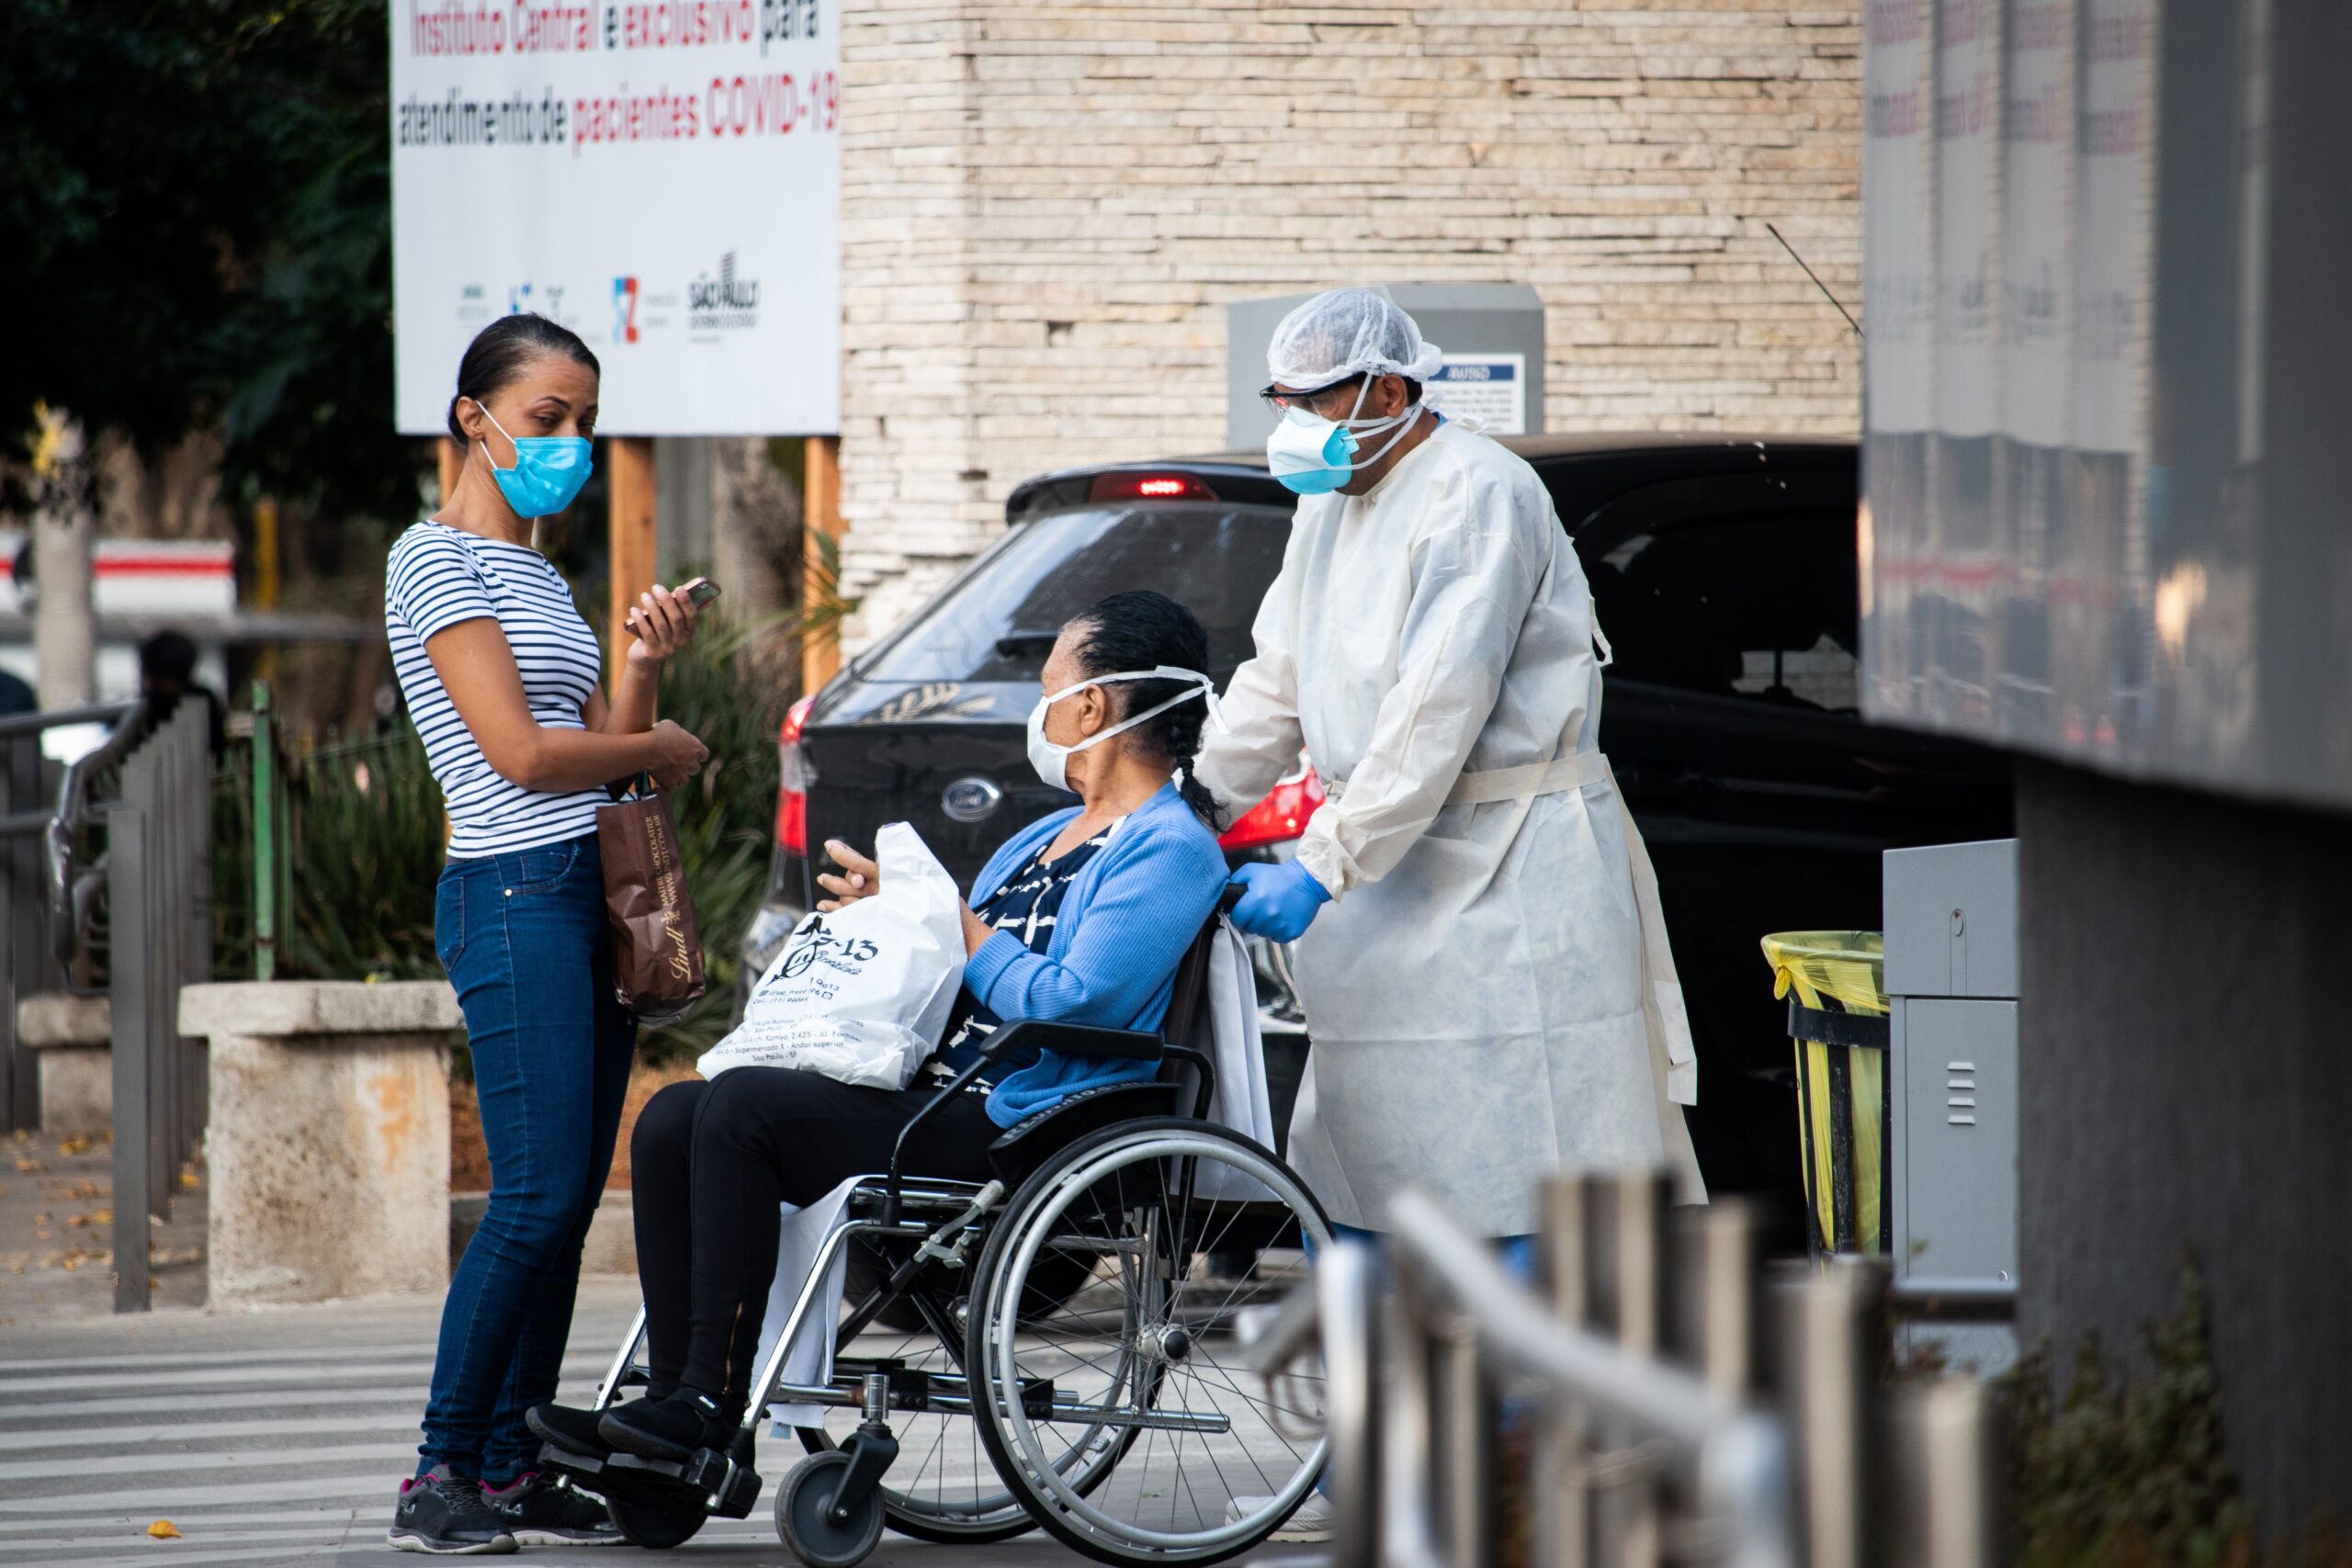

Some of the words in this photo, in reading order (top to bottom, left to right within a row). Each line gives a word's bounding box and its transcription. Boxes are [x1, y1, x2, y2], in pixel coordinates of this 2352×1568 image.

[411, 0, 506, 55] Instituto
[511, 0, 598, 52] Central
[624, 0, 755, 49] exclusivo
[761, 0, 820, 59] para
[399, 84, 537, 146] atendimento
[538, 84, 567, 143] de
[571, 81, 699, 159] pacientes
[707, 71, 839, 136] COVID-19
[666, 926, 693, 983] Lindt
[735, 1044, 779, 1055] Supermercado
[791, 1041, 811, 1049] Andar
[813, 1040, 844, 1049] superior
[492, 1498, 524, 1516] FILA
